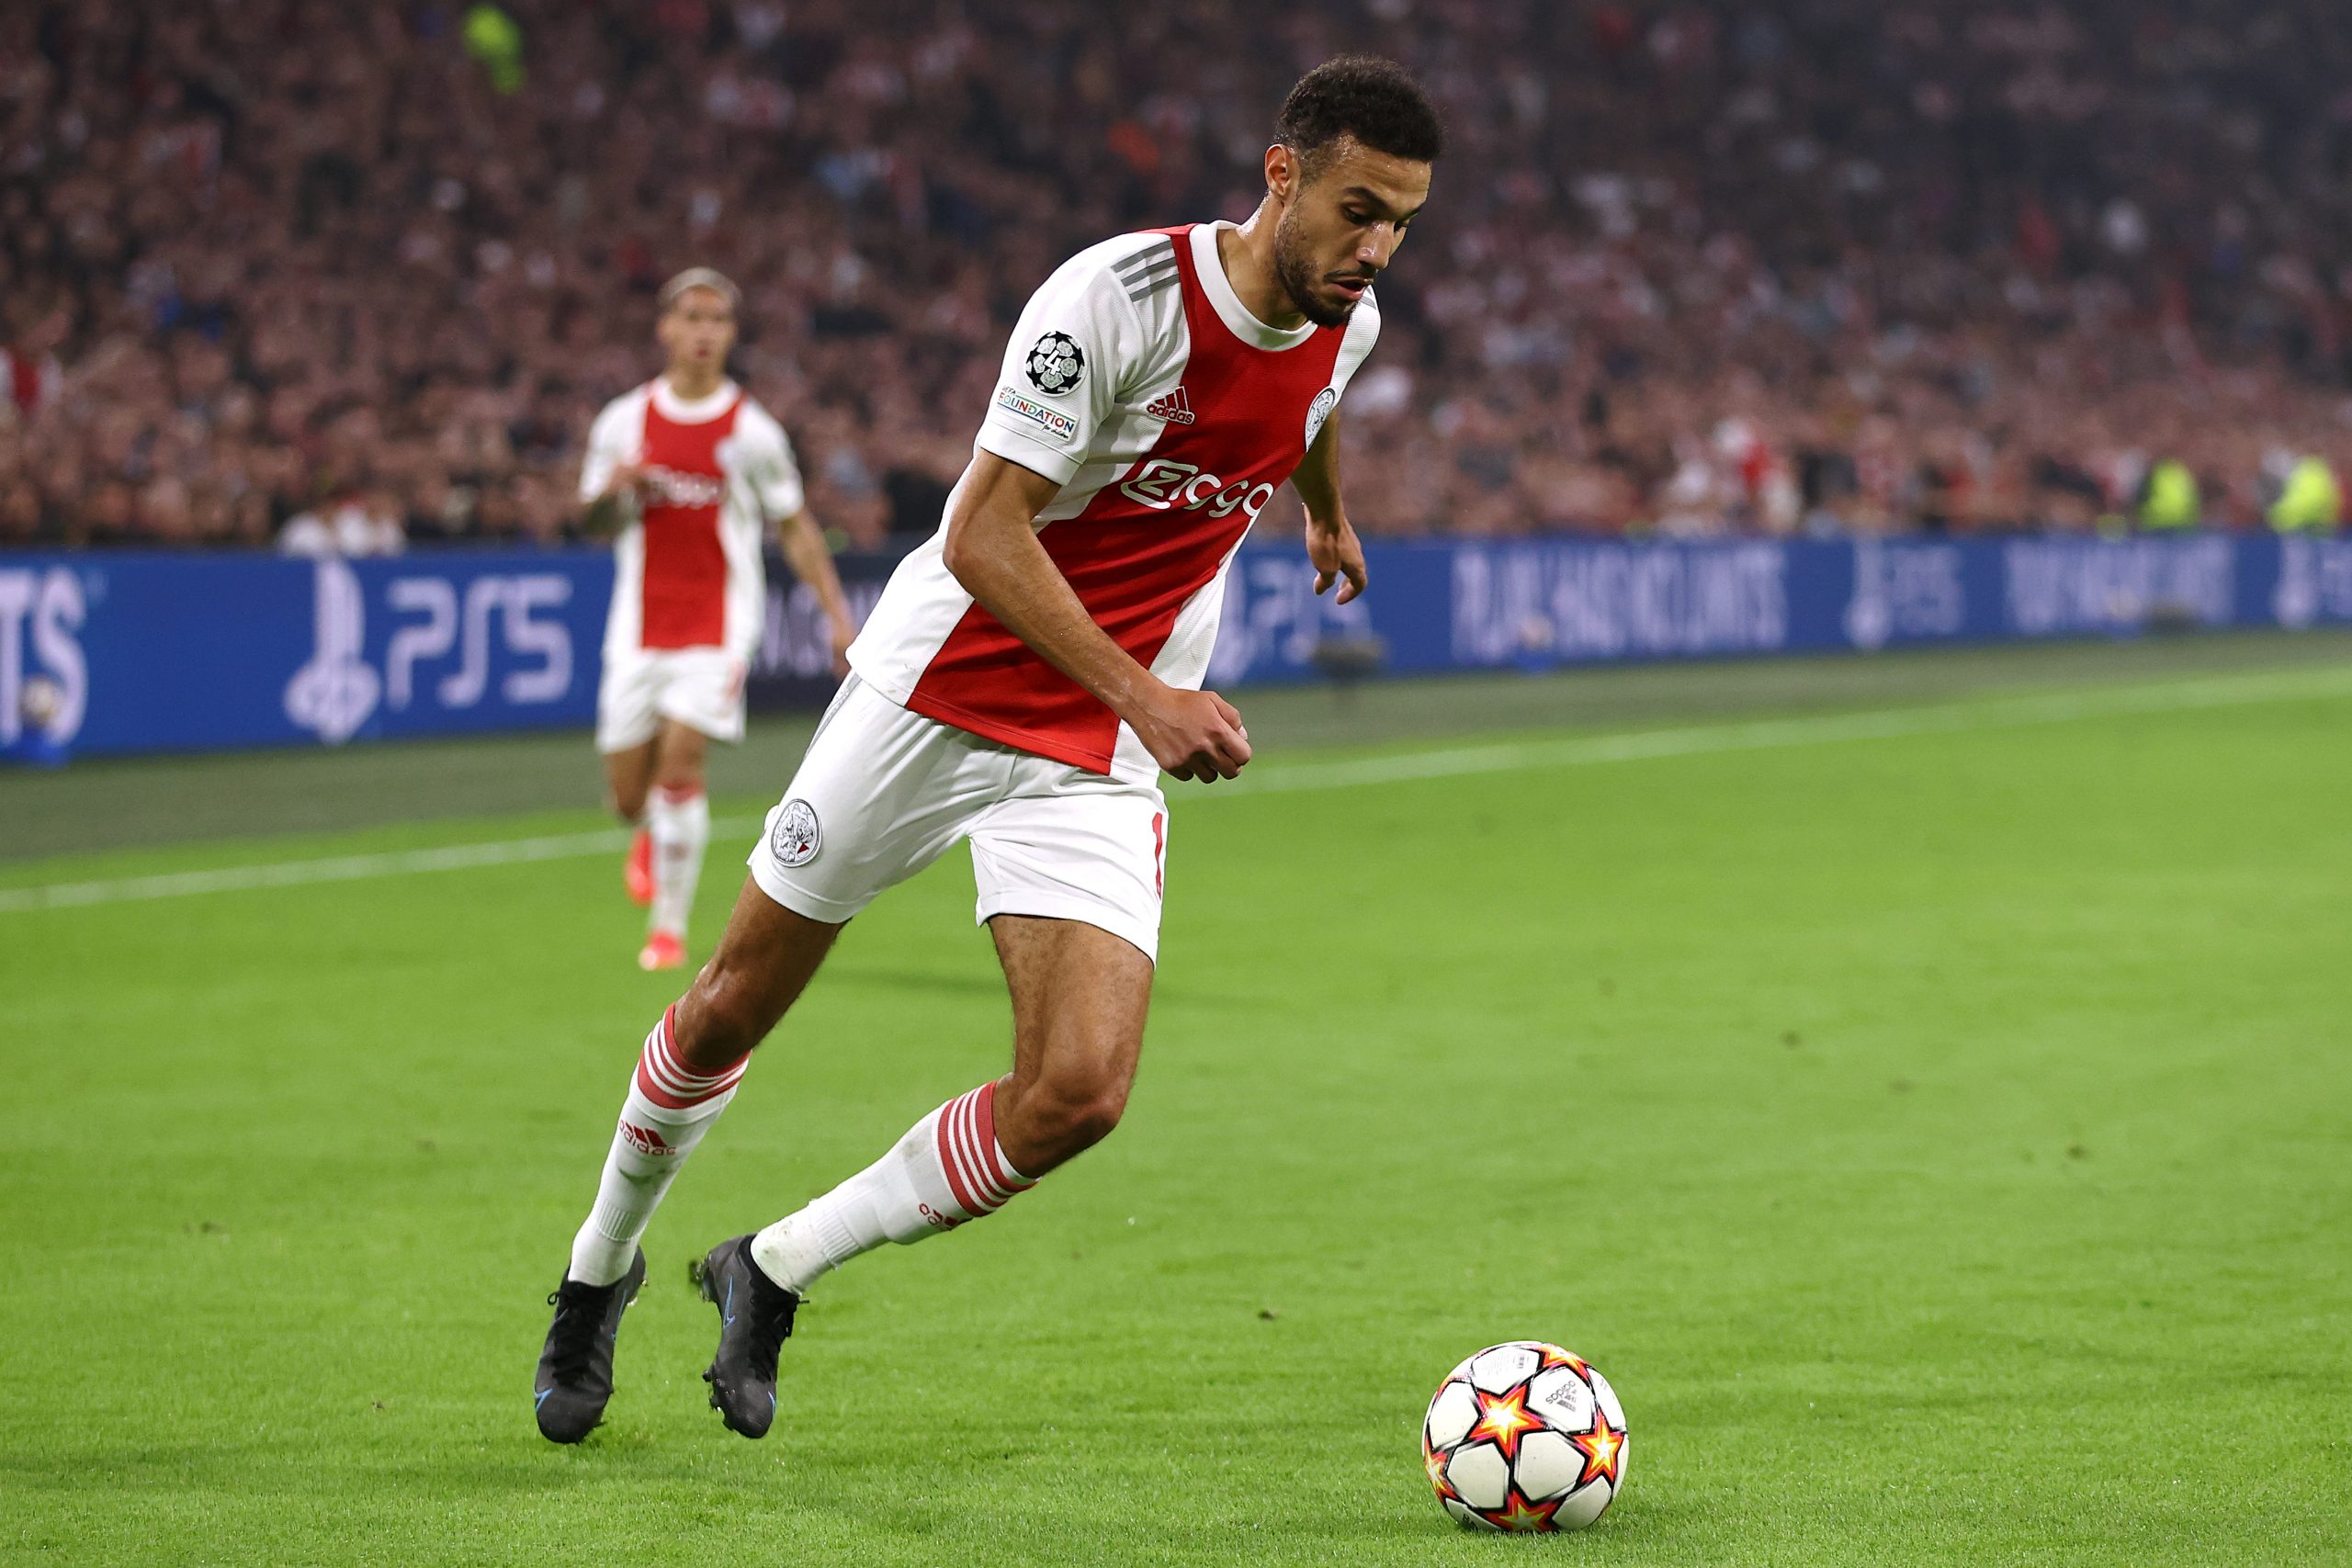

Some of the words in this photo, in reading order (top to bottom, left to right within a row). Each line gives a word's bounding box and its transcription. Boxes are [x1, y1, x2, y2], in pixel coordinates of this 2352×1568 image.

[1043, 350, 1062, 376] 4
[1147, 404, 1193, 423] adidas
[386, 574, 574, 710] PS5
[619, 1119, 677, 1156] adidas
[1545, 1381, 1577, 1404] adidas
